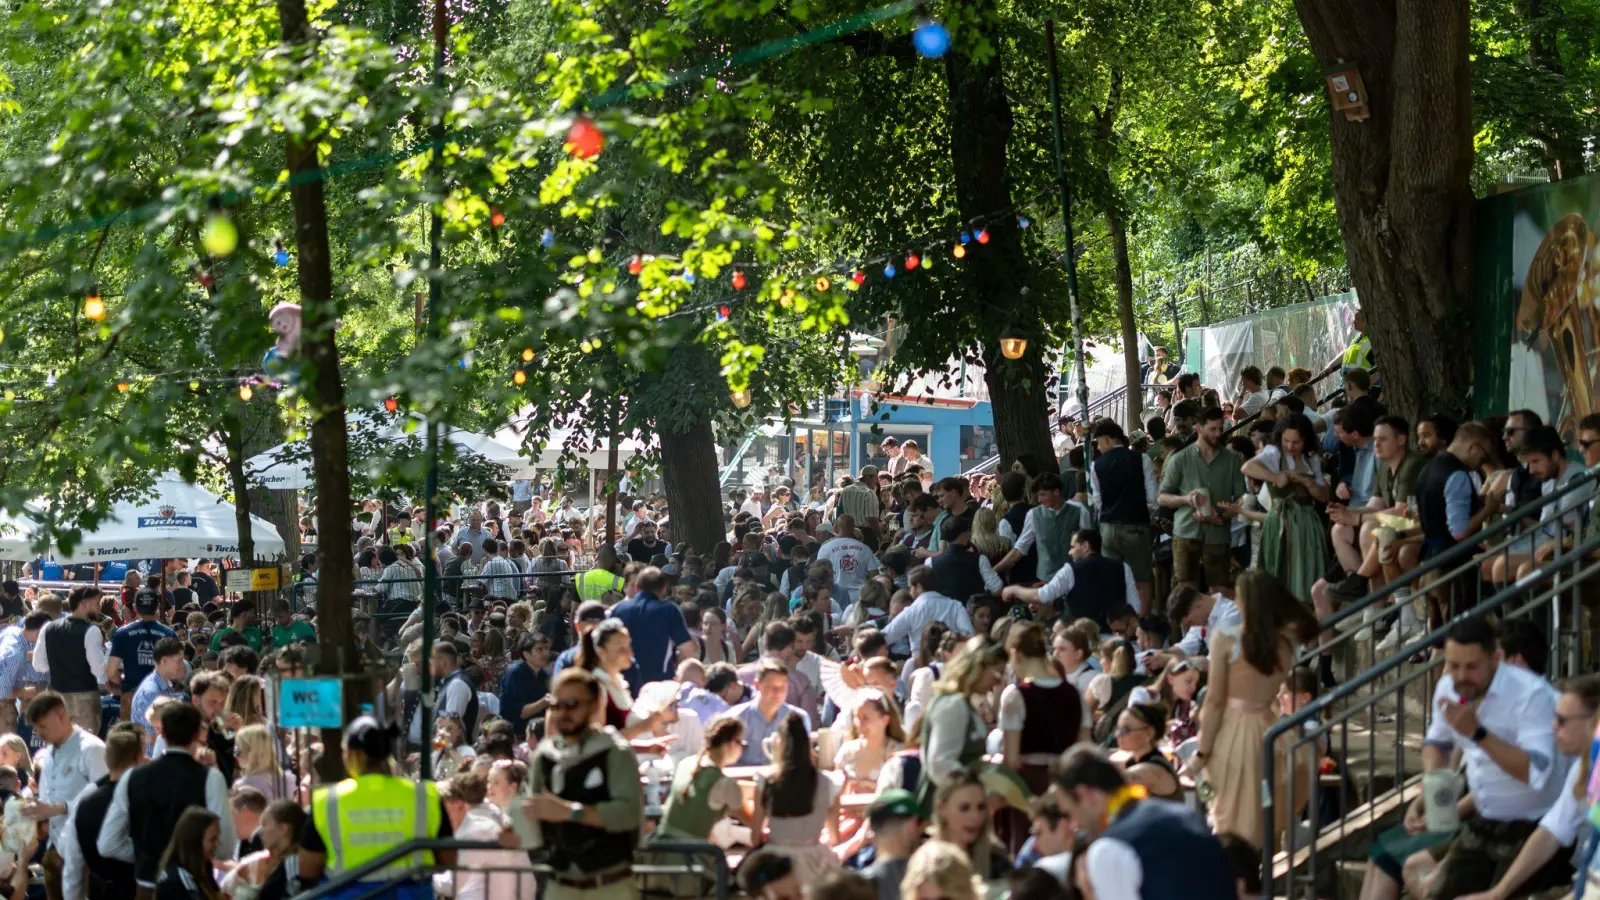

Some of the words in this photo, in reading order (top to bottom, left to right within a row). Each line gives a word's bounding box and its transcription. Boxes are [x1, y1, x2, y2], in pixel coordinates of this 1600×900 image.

[259, 475, 285, 483] Tucher
[143, 518, 192, 526] Tucher
[97, 547, 130, 556] Tucher
[215, 544, 240, 552] Tuche
[292, 690, 319, 704] WC
